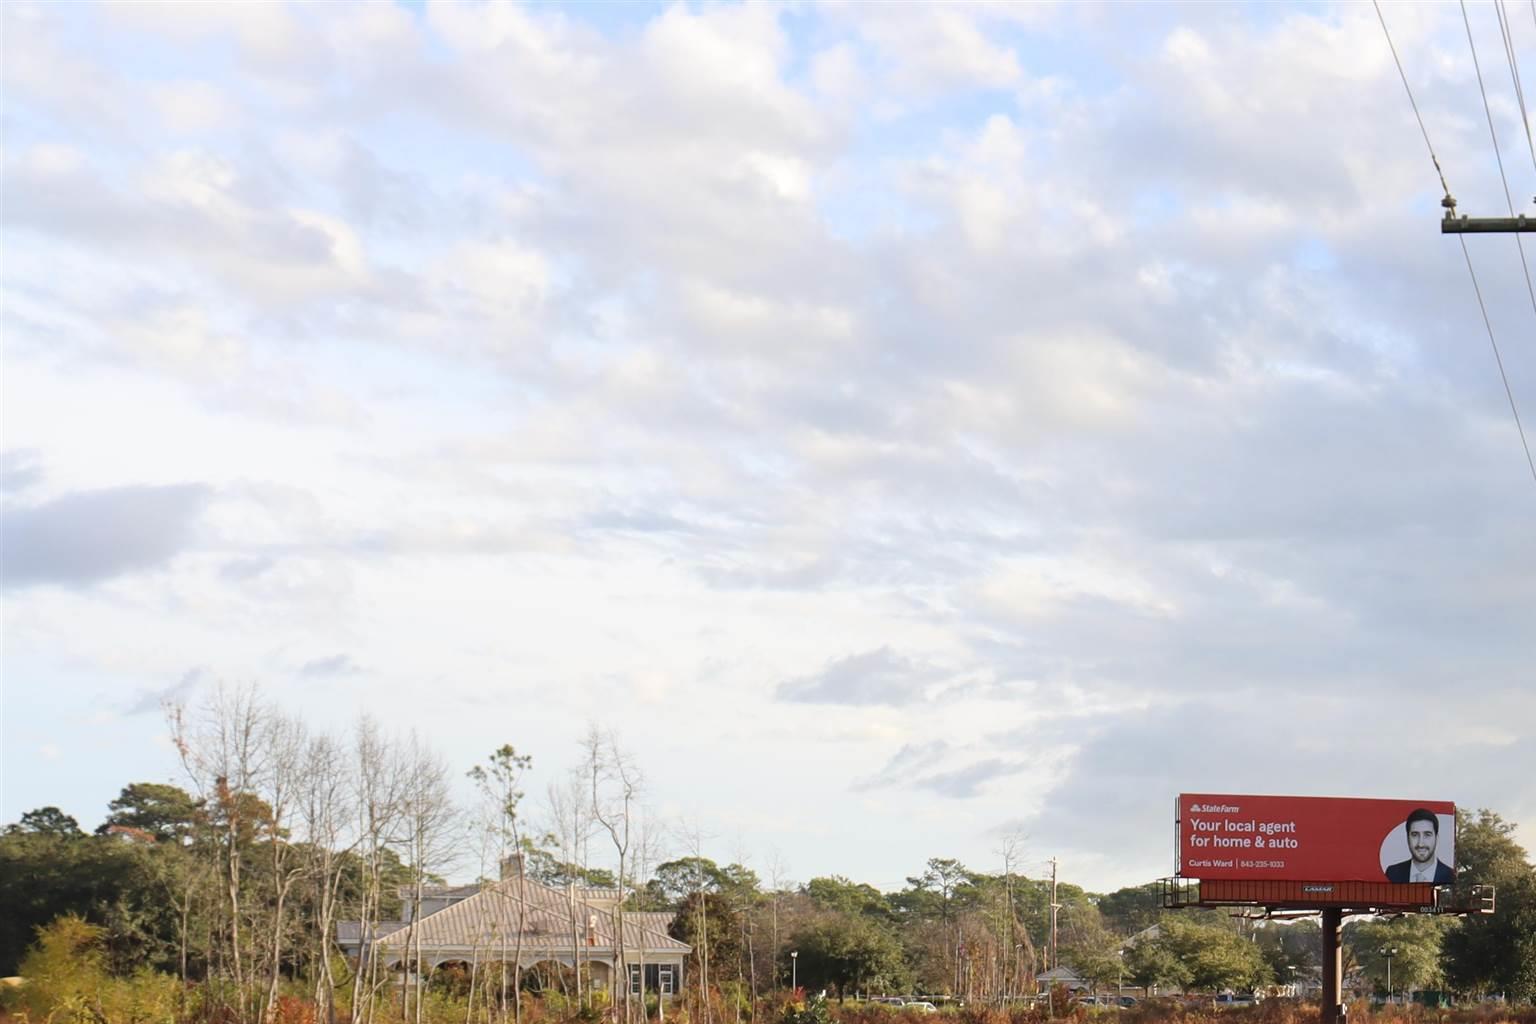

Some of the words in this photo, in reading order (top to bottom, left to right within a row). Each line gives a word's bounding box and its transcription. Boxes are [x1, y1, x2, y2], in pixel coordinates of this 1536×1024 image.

[1190, 818, 1221, 831] Your
[1225, 819, 1255, 832] local
[1259, 821, 1296, 835] agent
[1190, 834, 1210, 847] for
[1213, 835, 1251, 848] home
[1254, 835, 1265, 848] &
[1268, 837, 1298, 849] auto
[1188, 859, 1211, 868] Curtis
[1213, 859, 1233, 868] Ward
